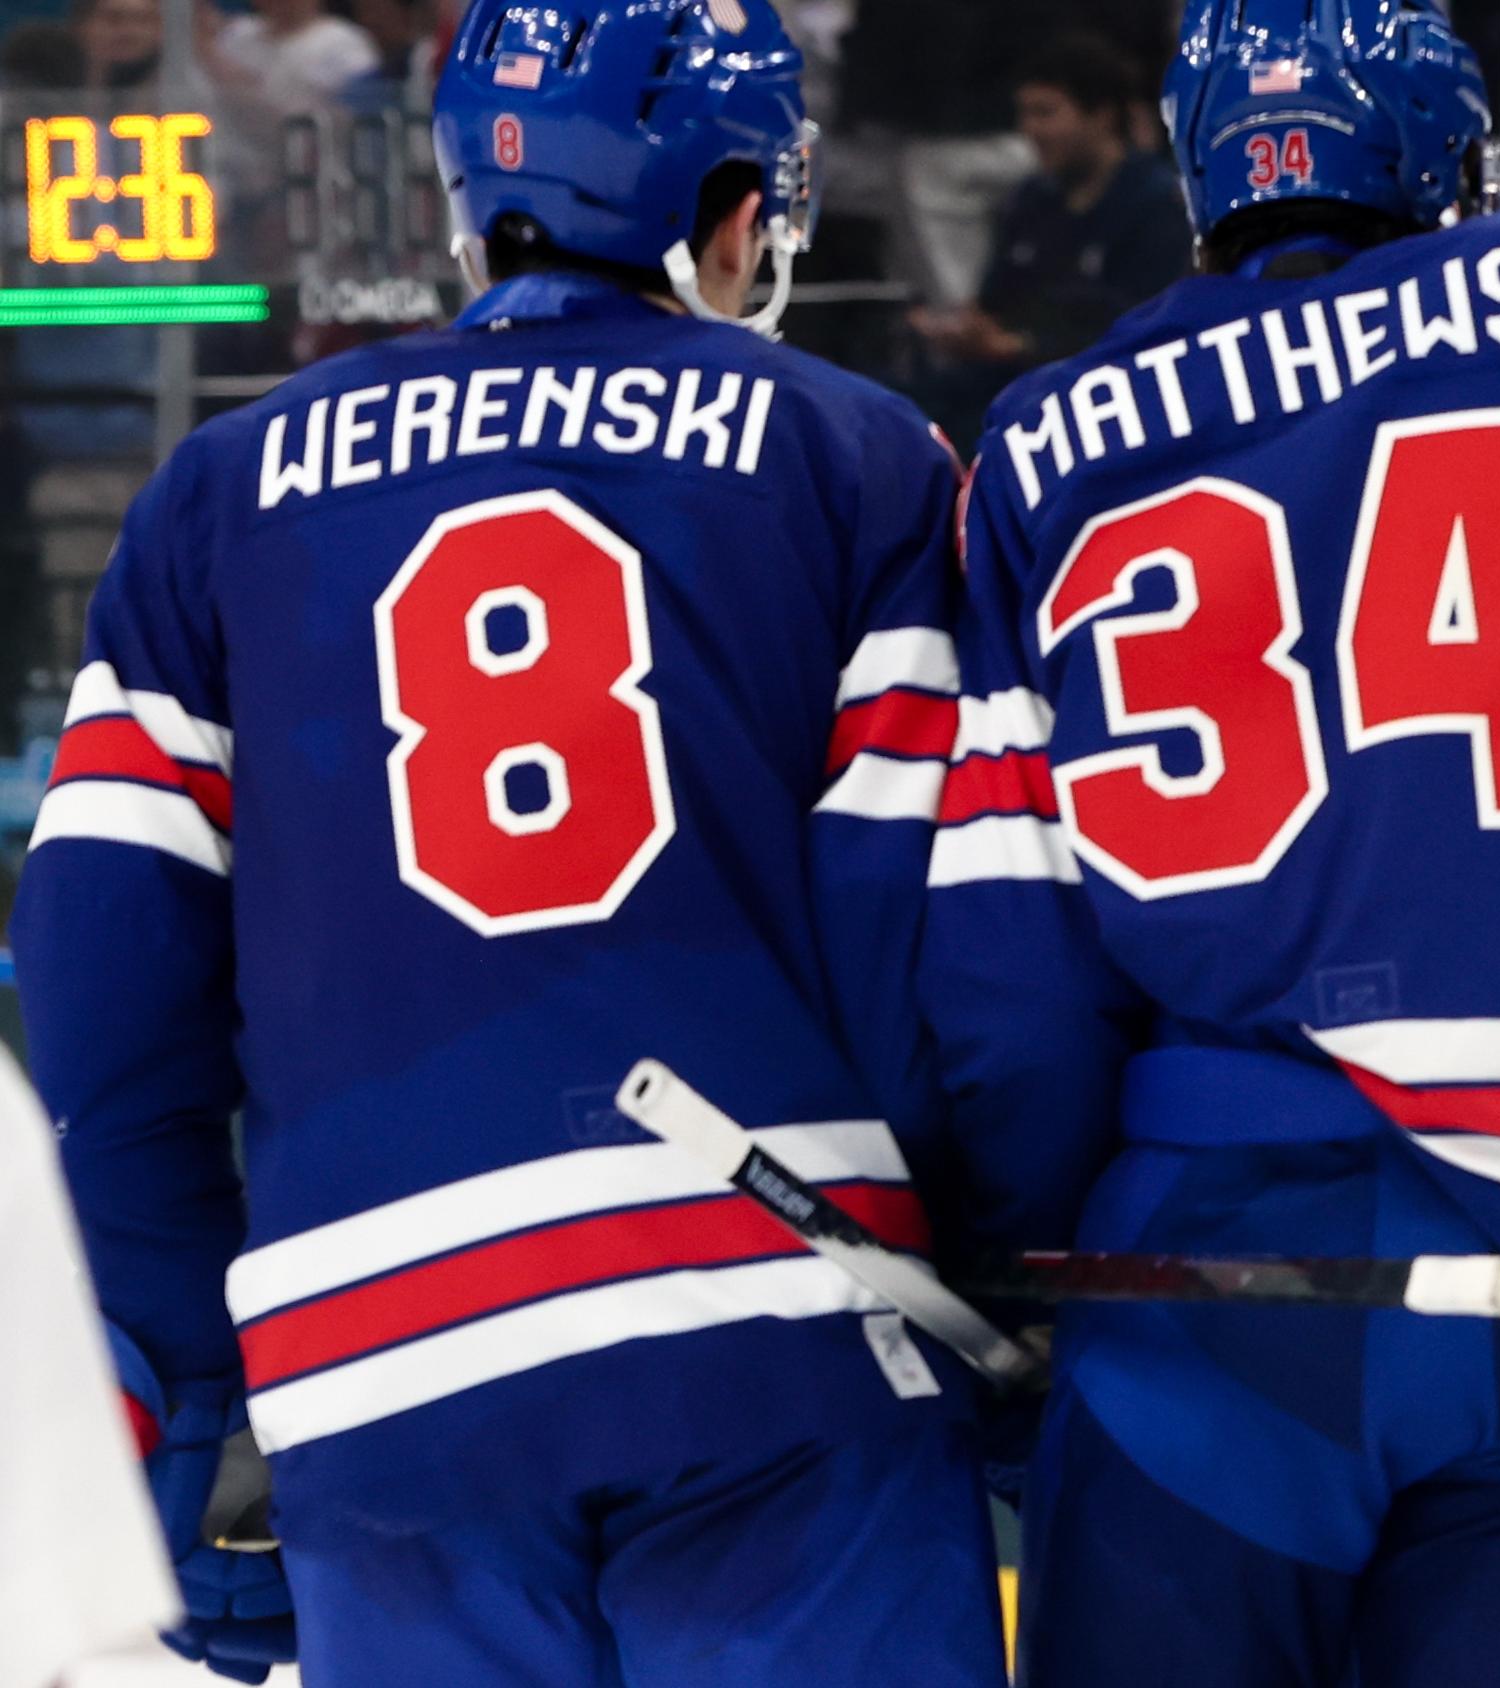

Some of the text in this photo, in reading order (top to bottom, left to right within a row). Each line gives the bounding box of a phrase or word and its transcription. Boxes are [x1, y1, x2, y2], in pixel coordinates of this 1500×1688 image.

[25, 113, 214, 263] 12:36
[493, 112, 523, 171] 8
[1245, 127, 1314, 190] 34
[258, 366, 775, 510] WERENSKI
[373, 488, 676, 938] 8
